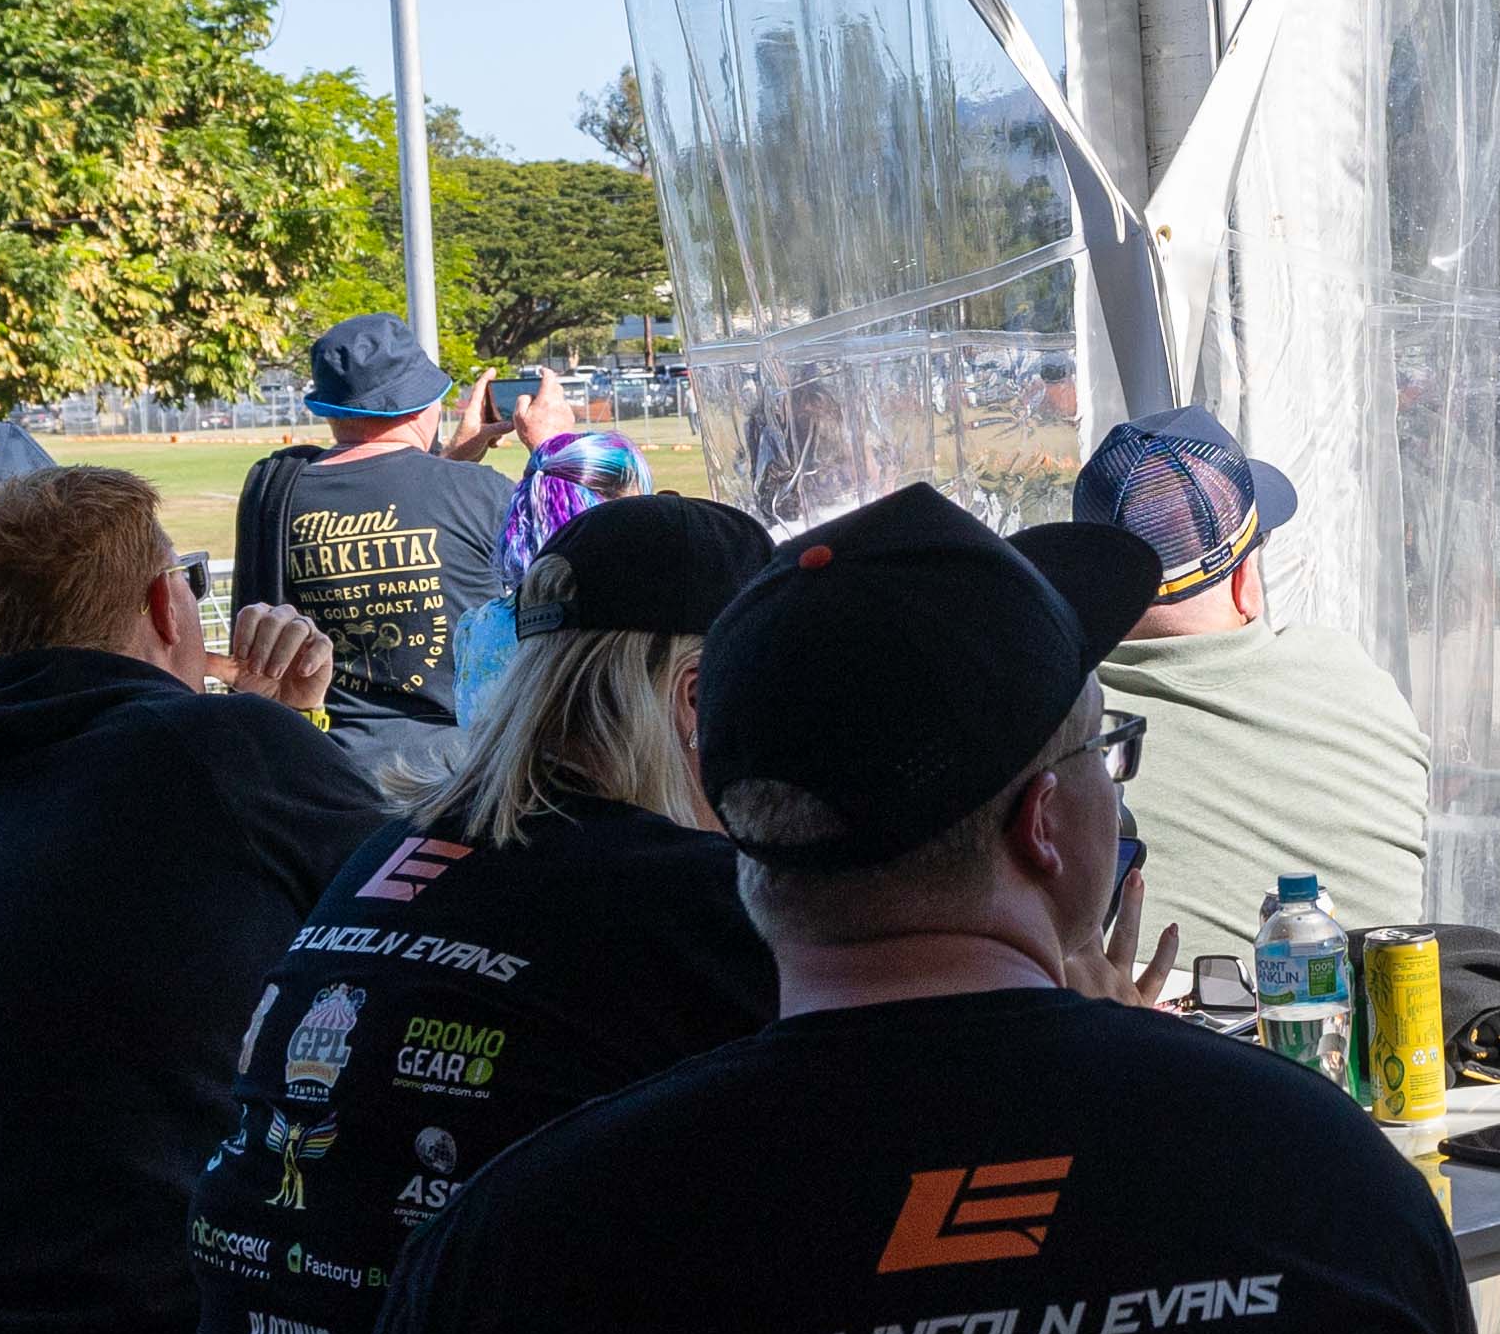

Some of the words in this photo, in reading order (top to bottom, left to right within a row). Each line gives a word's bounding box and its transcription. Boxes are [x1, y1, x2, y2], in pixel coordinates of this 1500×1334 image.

[292, 504, 398, 544] Miami
[379, 577, 440, 596] PARADE
[324, 606, 359, 620] GOLD
[424, 595, 444, 611] AU
[408, 634, 425, 647] 20
[424, 615, 447, 668] AGAIN
[305, 925, 410, 955] LINCOLN
[400, 935, 532, 983] EVANS
[289, 1026, 351, 1064] GPL
[403, 1016, 506, 1058] PROMO
[304, 1254, 363, 1288] Factory
